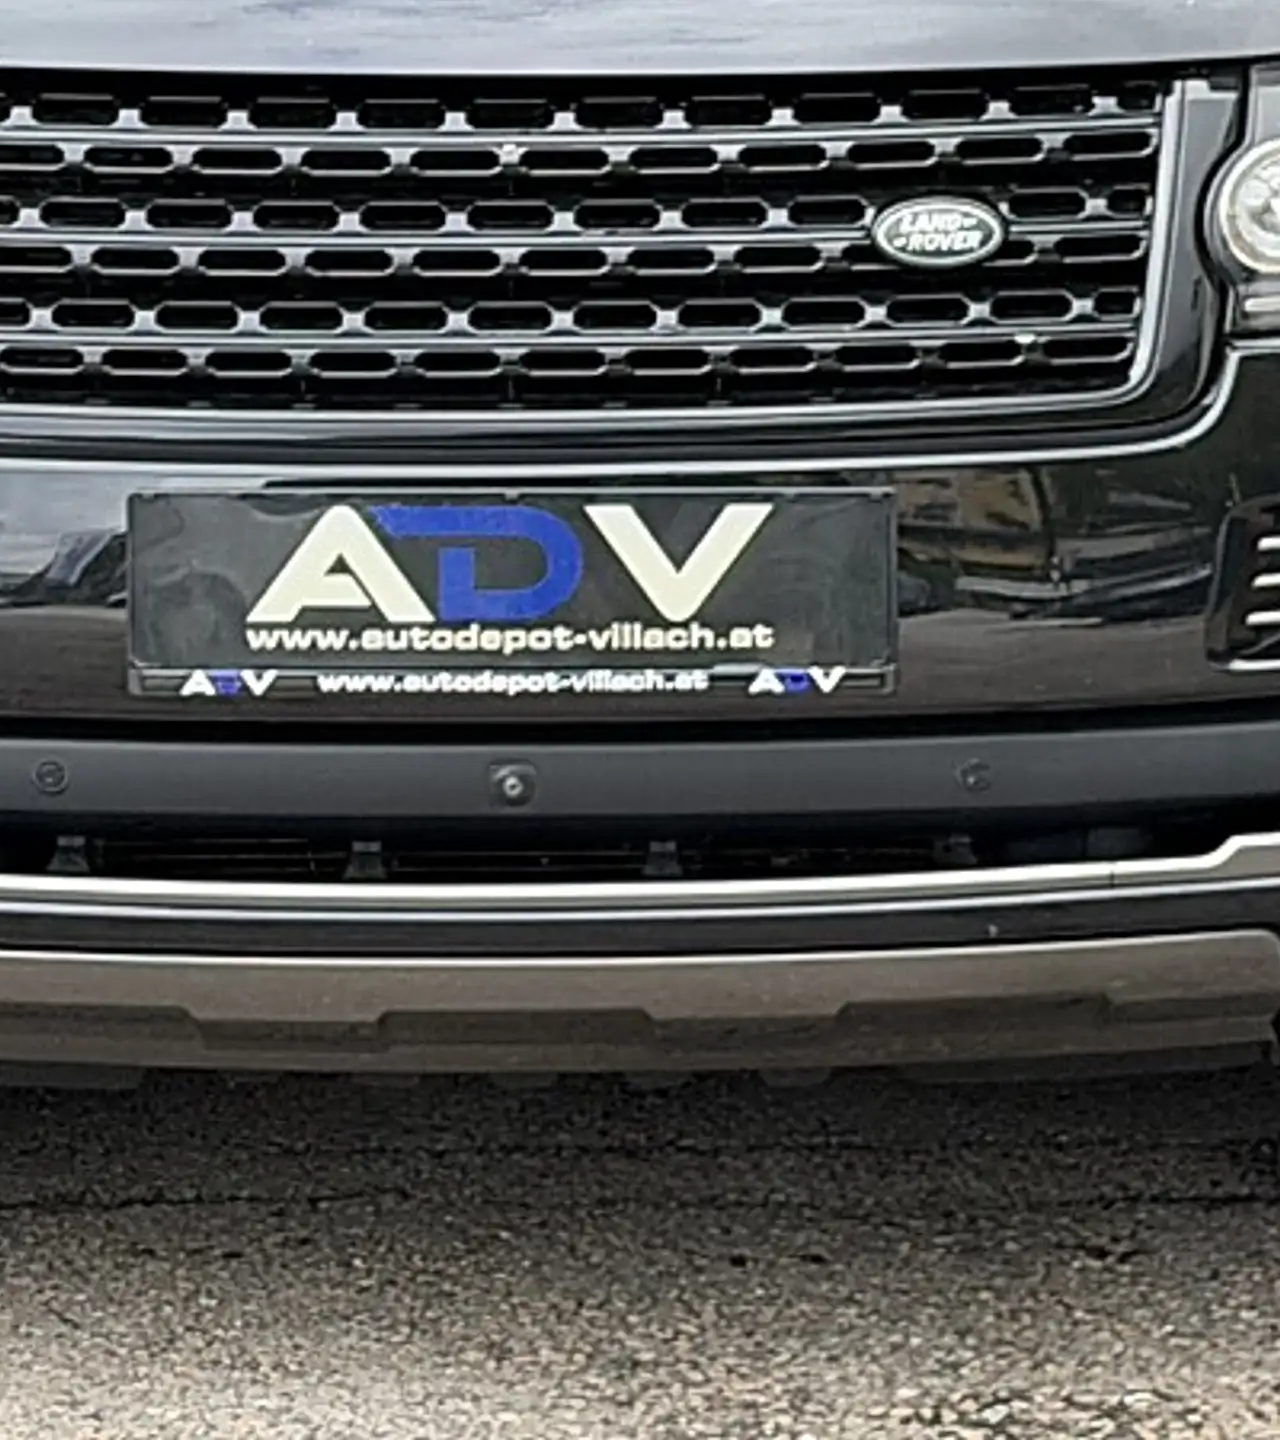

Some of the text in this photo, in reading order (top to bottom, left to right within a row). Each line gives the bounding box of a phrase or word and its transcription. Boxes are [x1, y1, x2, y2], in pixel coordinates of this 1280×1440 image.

[246, 503, 774, 623] ADV
[246, 622, 775, 655] www.autodepot-villach.at
[180, 669, 278, 697] ADV
[317, 670, 709, 696] www.autodepot-villach.at
[748, 666, 846, 694] ADV
